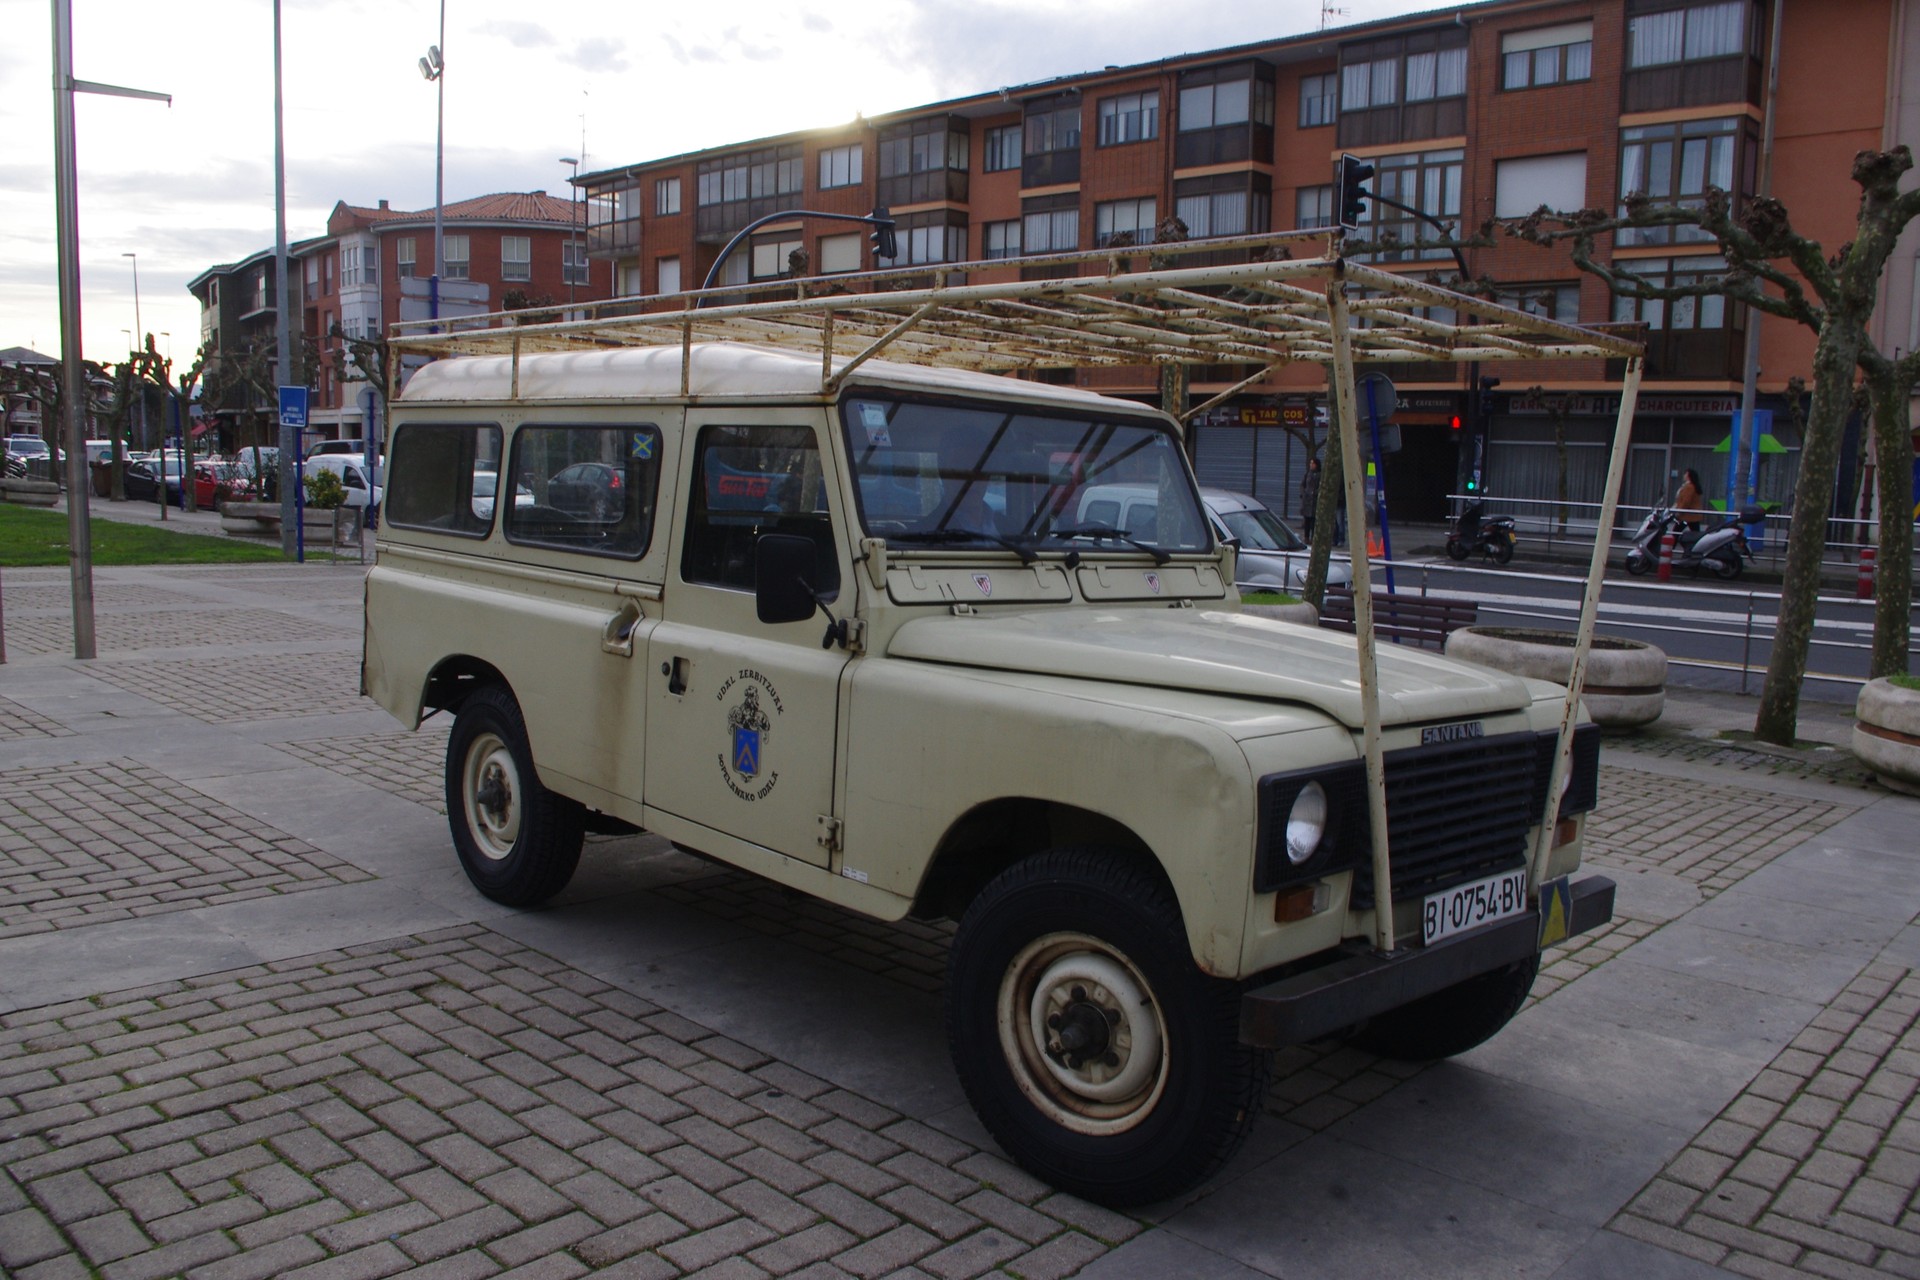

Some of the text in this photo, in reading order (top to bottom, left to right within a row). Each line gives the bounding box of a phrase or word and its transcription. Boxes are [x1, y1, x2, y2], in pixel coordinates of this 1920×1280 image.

[1258, 409, 1303, 419] TABCOS
[1638, 400, 1733, 411] CHARCUTERIA
[717, 669, 784, 716] UDAL ZERBITZUAK
[1423, 722, 1483, 743] SANTANA
[718, 753, 779, 802] SOPELANAKO UDALA
